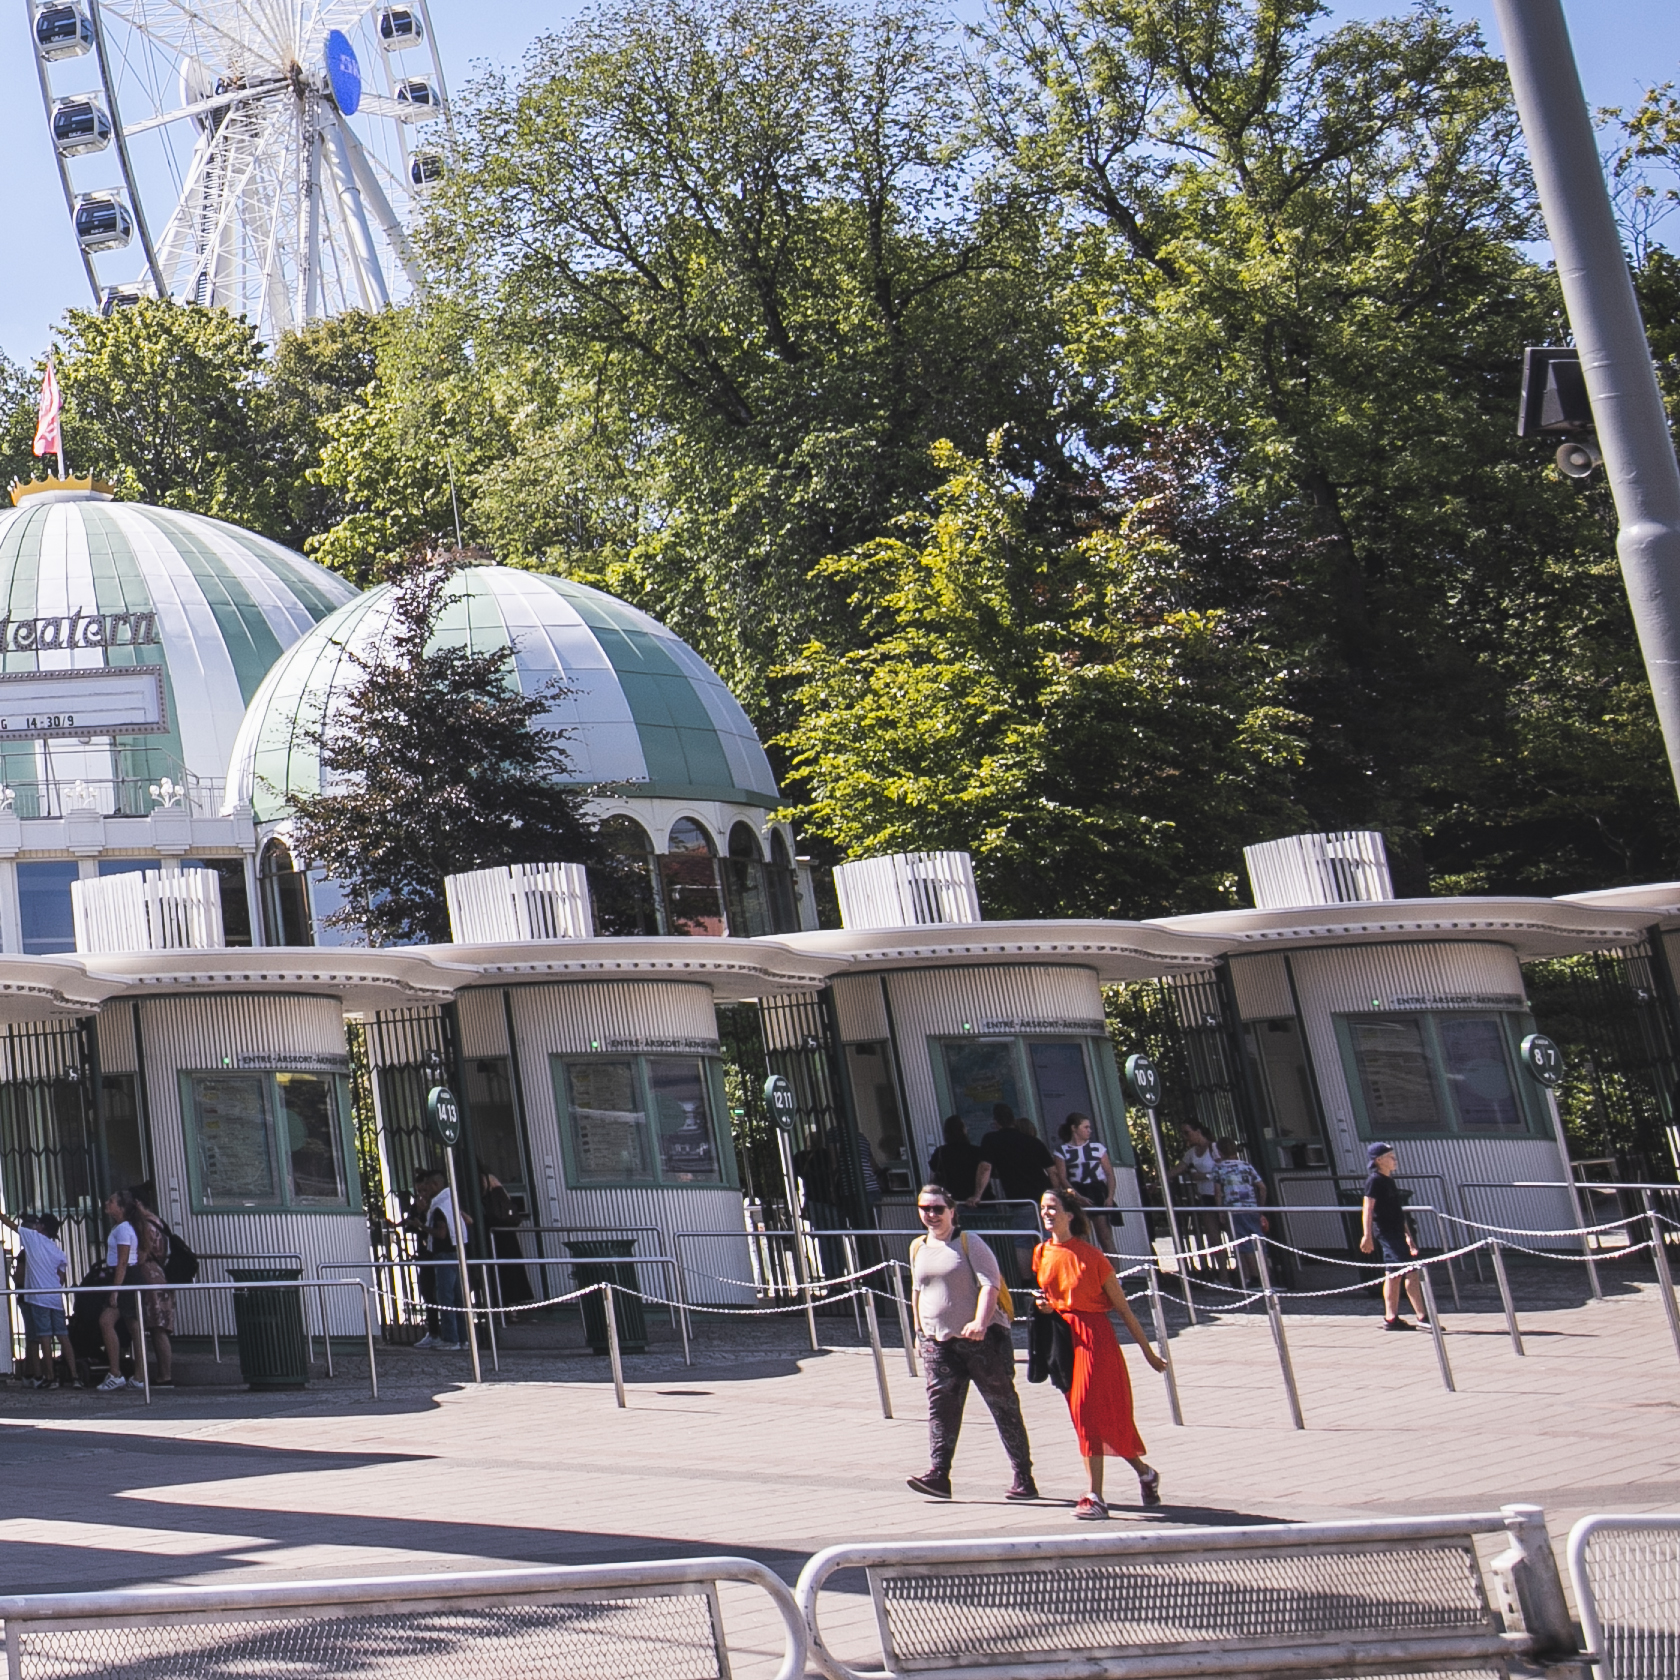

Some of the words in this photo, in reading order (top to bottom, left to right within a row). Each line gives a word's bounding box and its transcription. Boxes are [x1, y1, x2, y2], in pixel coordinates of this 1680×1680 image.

[1534, 1048, 1543, 1065] 8
[1547, 1049, 1554, 1065] 7
[1134, 1069, 1147, 1086] 10
[1147, 1070, 1154, 1086] 9
[773, 1091, 784, 1108] 12
[783, 1092, 793, 1109] 11
[437, 1103, 447, 1121] 14
[447, 1104, 457, 1122] 13
